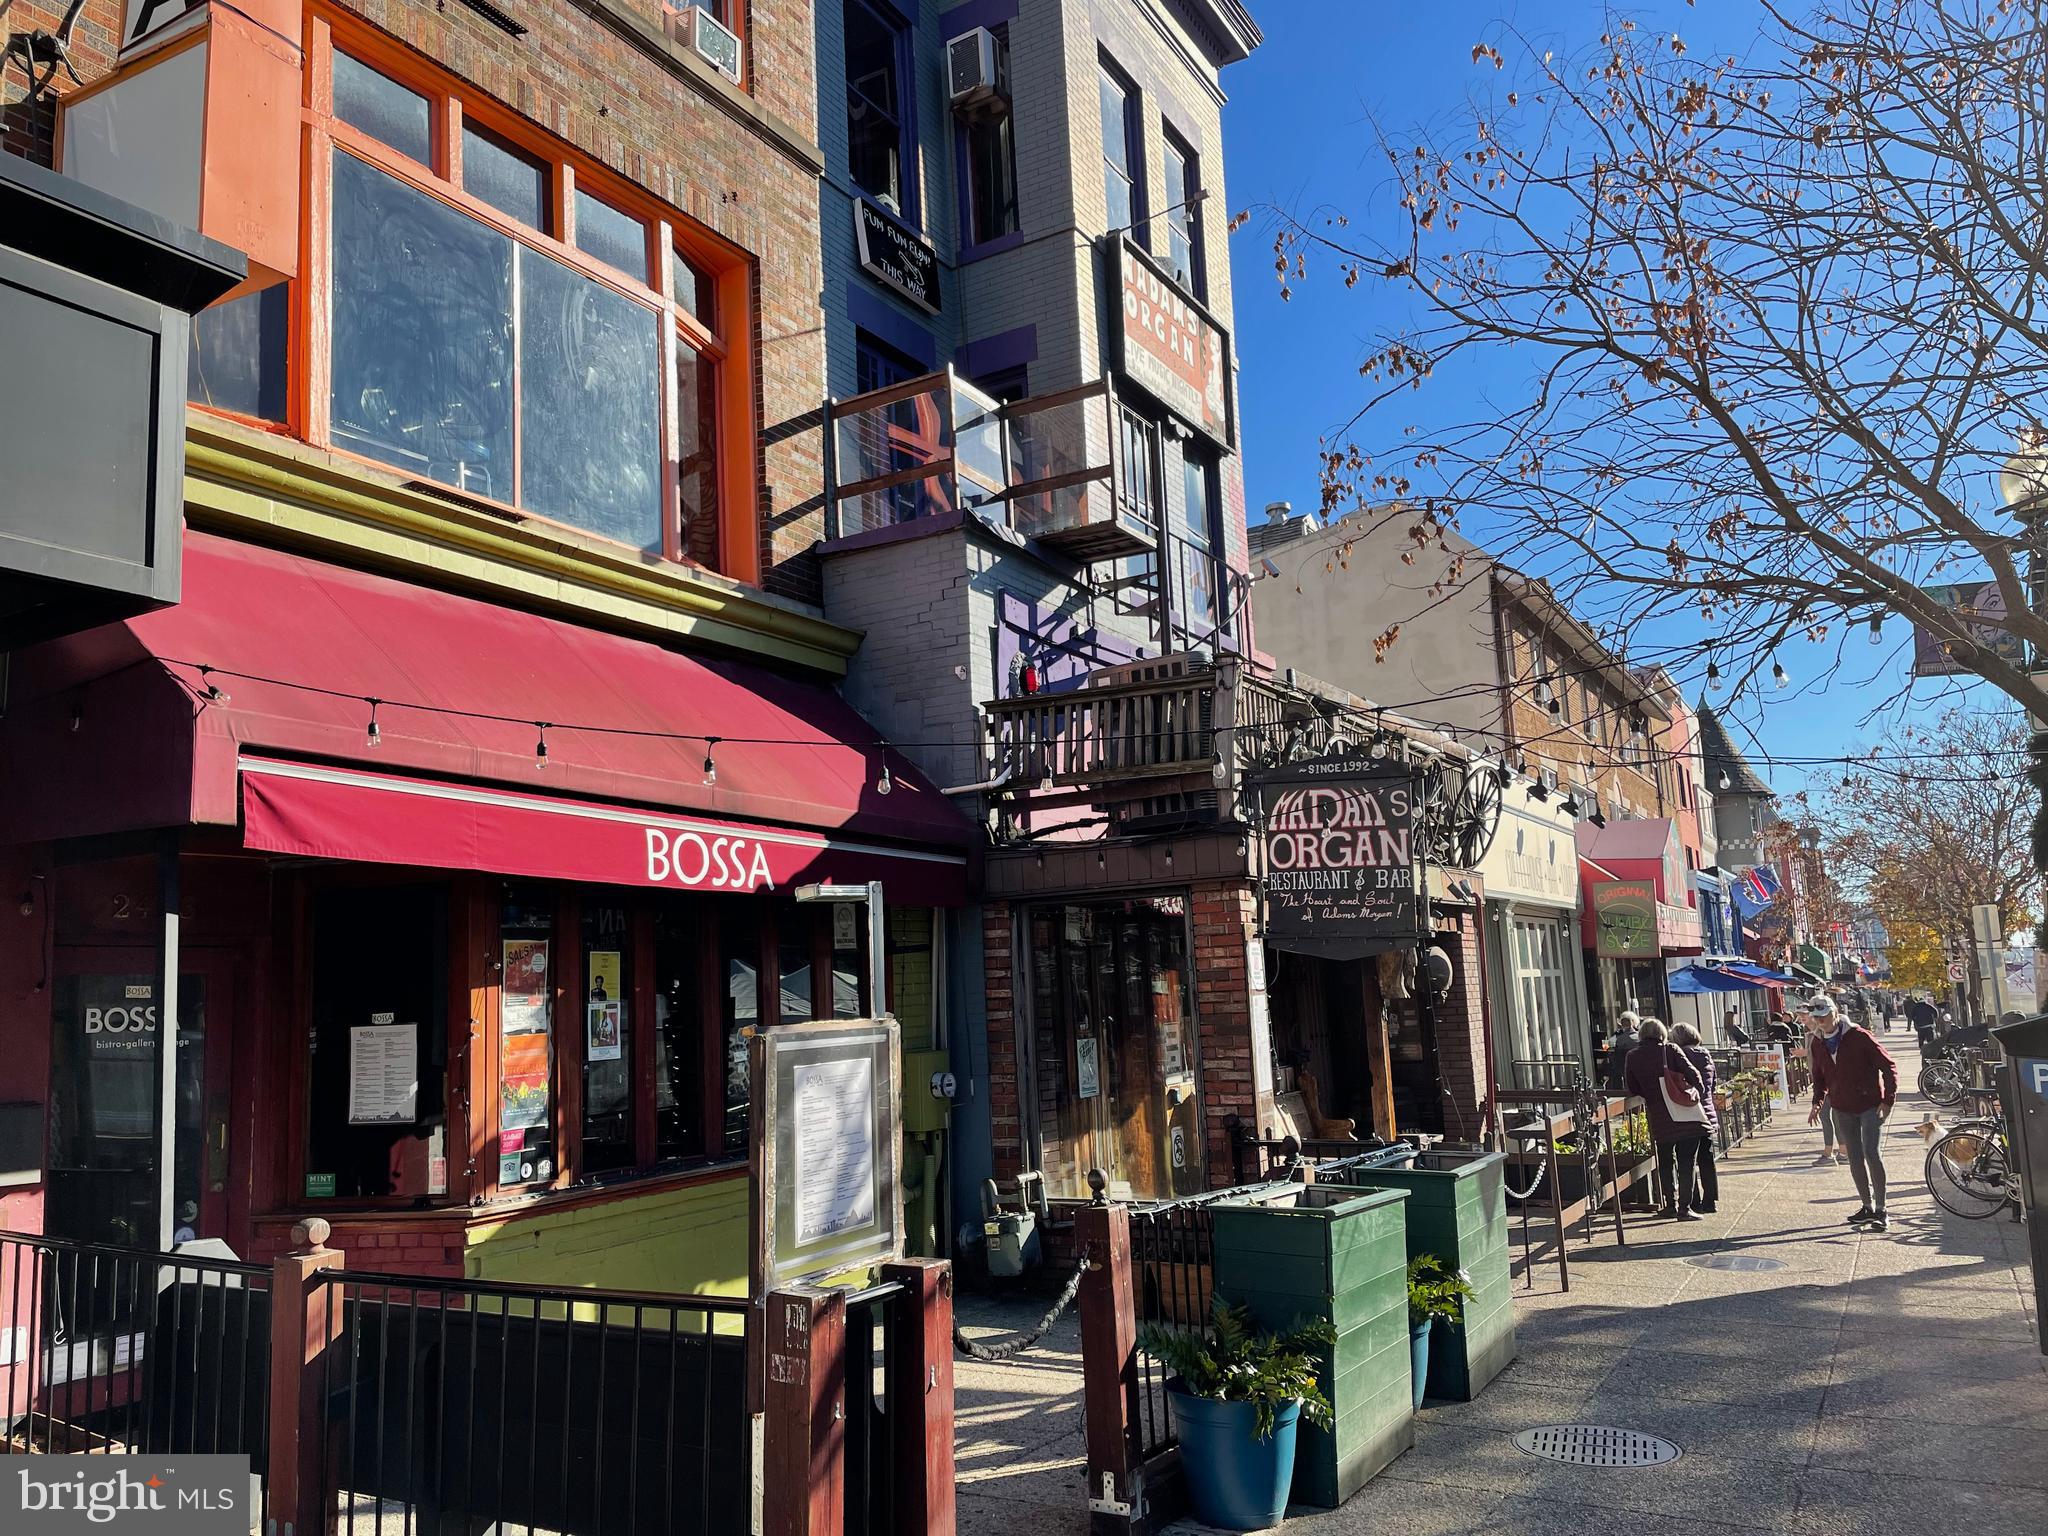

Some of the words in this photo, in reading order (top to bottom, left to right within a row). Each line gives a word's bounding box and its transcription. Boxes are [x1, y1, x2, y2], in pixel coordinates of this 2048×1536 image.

[863, 207, 884, 233] FUN
[887, 225, 908, 249] FUN
[880, 257, 904, 285] THIS
[907, 277, 927, 300] WAY
[1124, 287, 1195, 368] ORGAN
[1308, 762, 1341, 774] SINCE
[1343, 761, 1371, 772] 1992
[1268, 786, 1409, 831] MADAM'S
[645, 828, 775, 891] BOSSA
[1269, 828, 1410, 870] ORGAN
[1269, 870, 1351, 892] RESTAURANT
[1354, 868, 1366, 891] &
[1375, 869, 1412, 889] BAR
[1300, 892, 1333, 906] Heart
[1339, 894, 1360, 906] and
[1364, 890, 1395, 906] Soul
[1301, 908, 1314, 922] of
[1322, 907, 1357, 919] Adams
[126, 987, 151, 996] BOSSA
[309, 1175, 332, 1183] MINT
